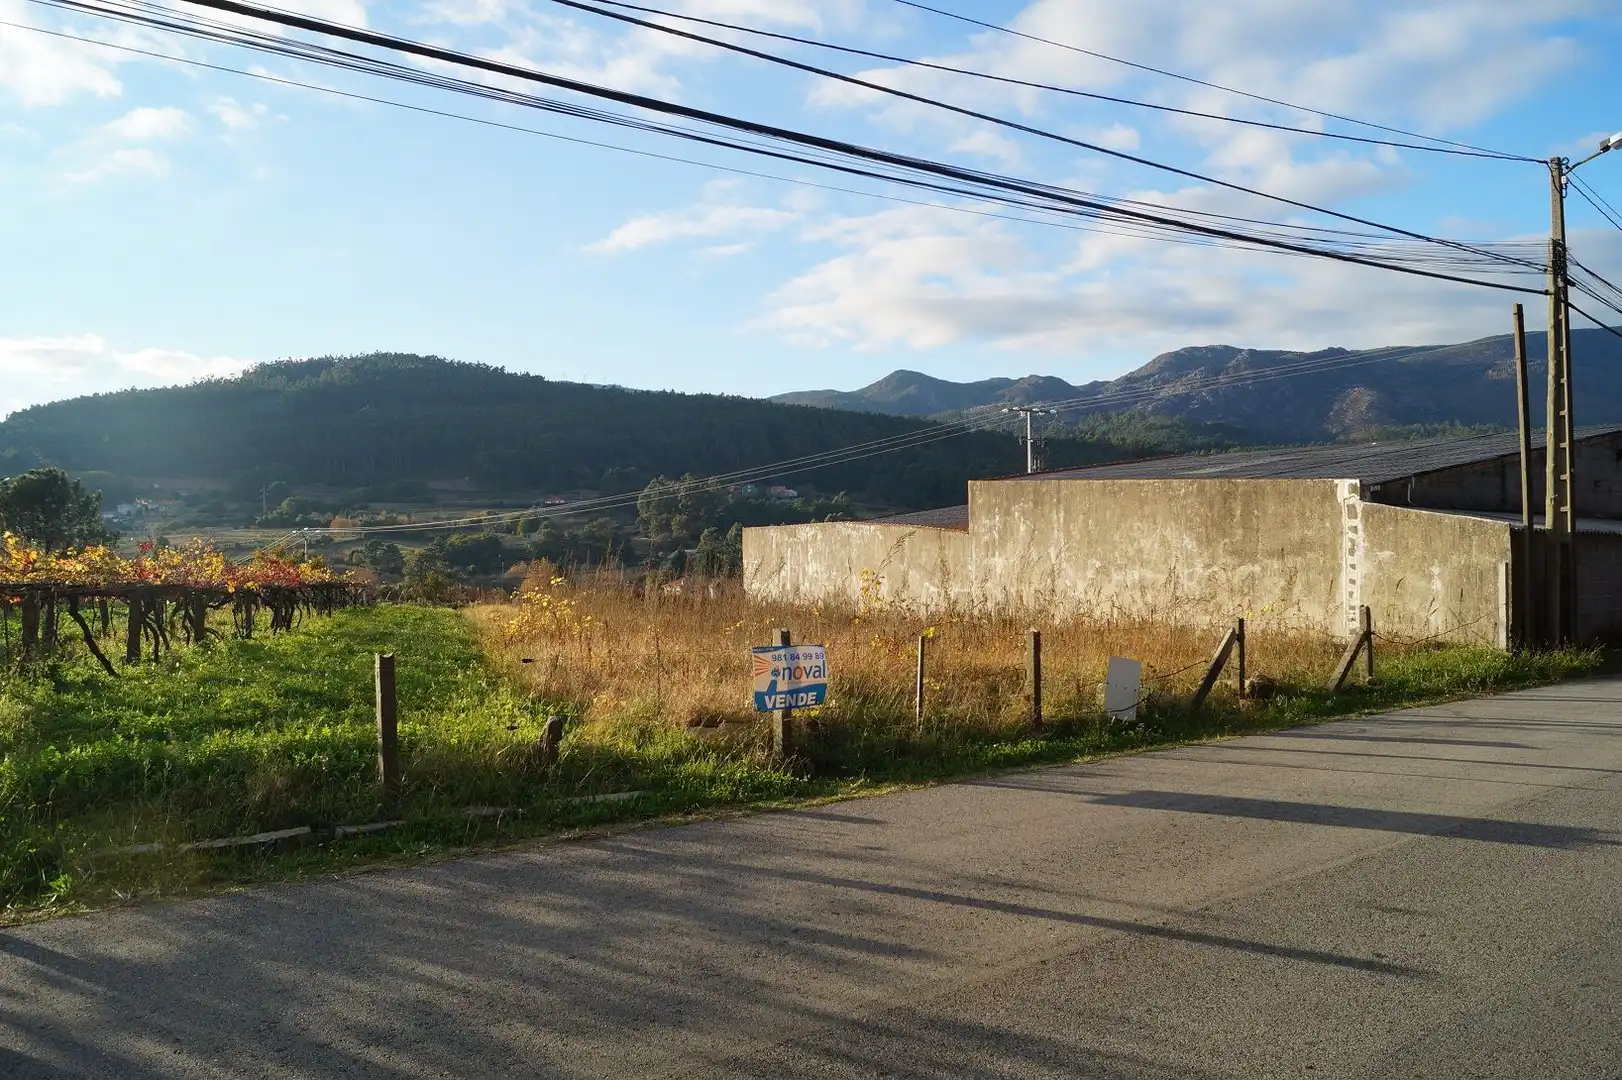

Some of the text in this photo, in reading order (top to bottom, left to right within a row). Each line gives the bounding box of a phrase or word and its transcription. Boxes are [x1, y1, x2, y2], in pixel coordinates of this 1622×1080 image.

[772, 653, 787, 662] 981
[790, 653, 800, 661] 84
[802, 652, 813, 661] 99
[764, 692, 817, 709] VENDE
